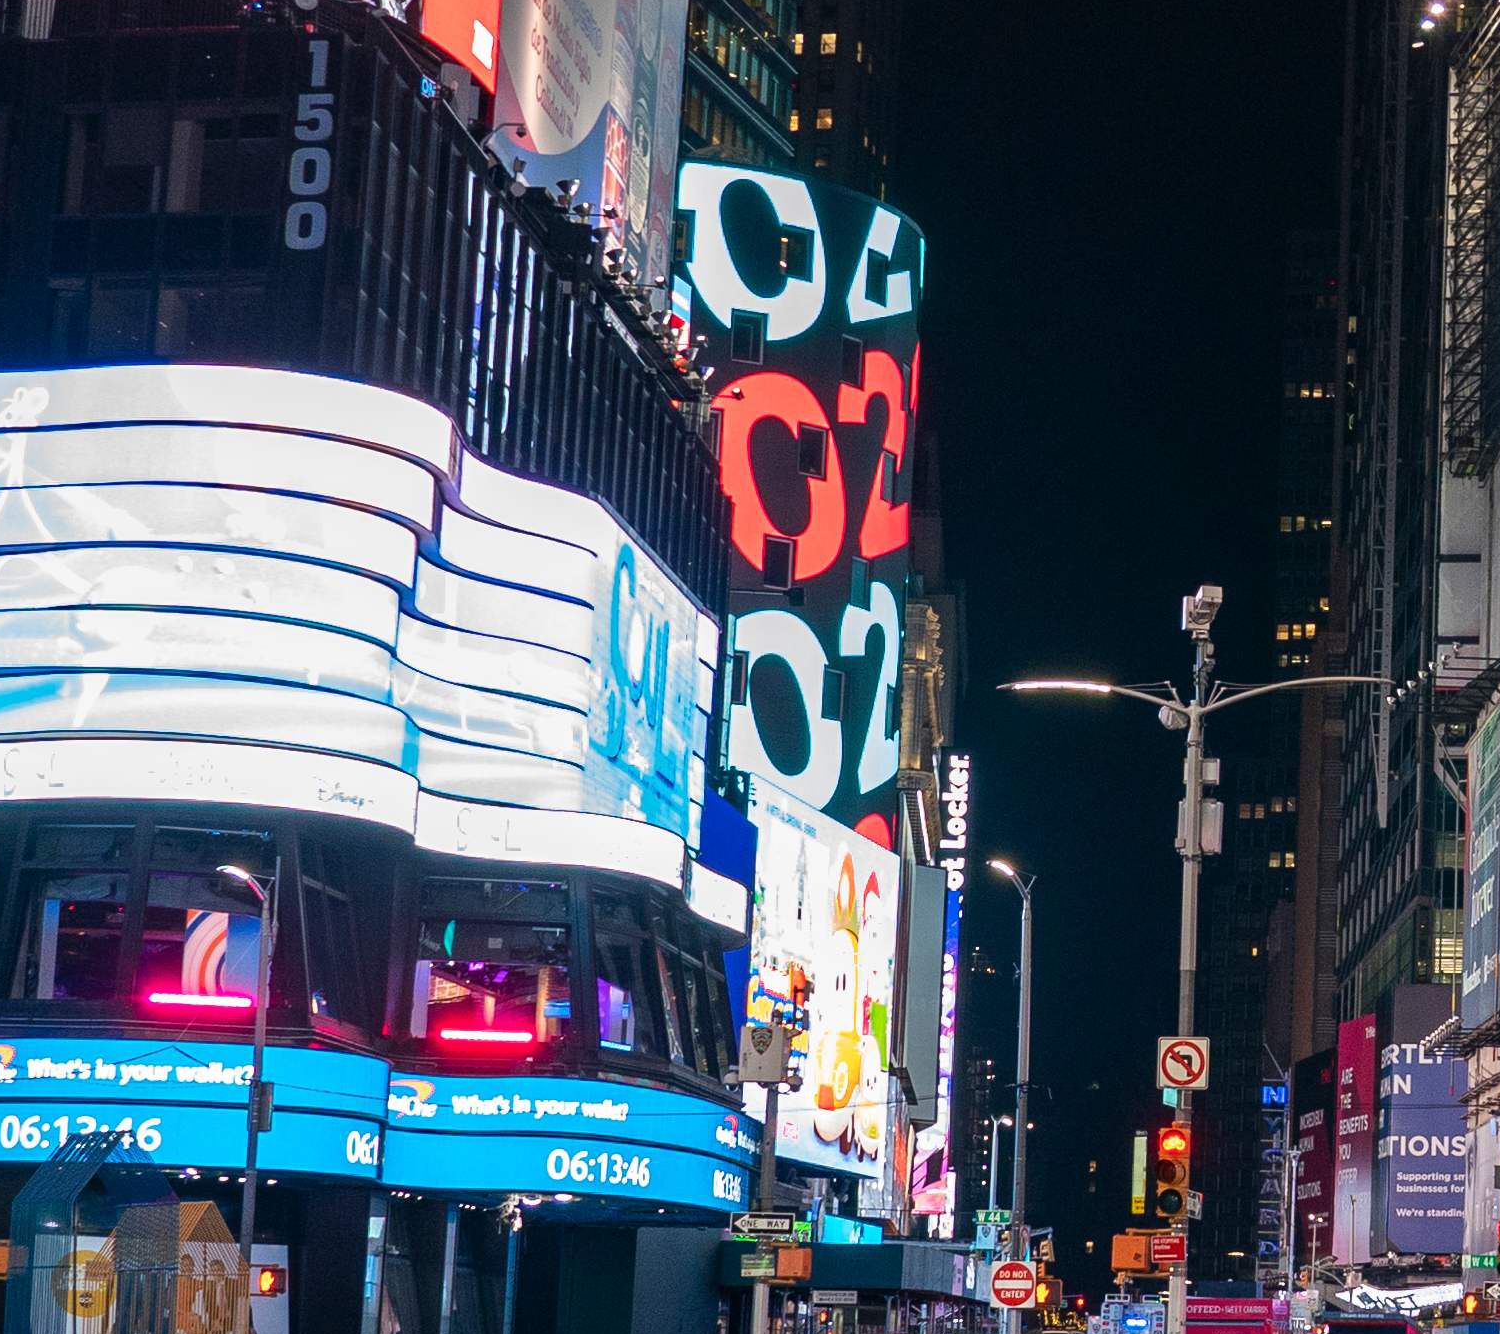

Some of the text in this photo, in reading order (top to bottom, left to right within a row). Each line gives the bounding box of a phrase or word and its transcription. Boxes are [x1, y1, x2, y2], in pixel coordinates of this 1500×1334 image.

[284, 39, 335, 250] 1500
[119, 1064, 173, 1087] your
[1341, 1067, 1353, 1085] ARE
[1340, 1092, 1352, 1110] THE
[1339, 1114, 1369, 1136] BENEFITS
[1339, 1143, 1351, 1162] YOU
[546, 1147, 651, 1188] 06:13:46
[1396, 1172, 1451, 1183] Supporting
[1396, 1184, 1448, 1194] businesses
[977, 1211, 1001, 1222] W 44
[1396, 1208, 1425, 1218] We're
[740, 1219, 786, 1228] ONE WAY
[1471, 1257, 1495, 1267] W 44
[999, 1270, 1028, 1279] DO NOT
[1000, 1291, 1026, 1299] ENTER
